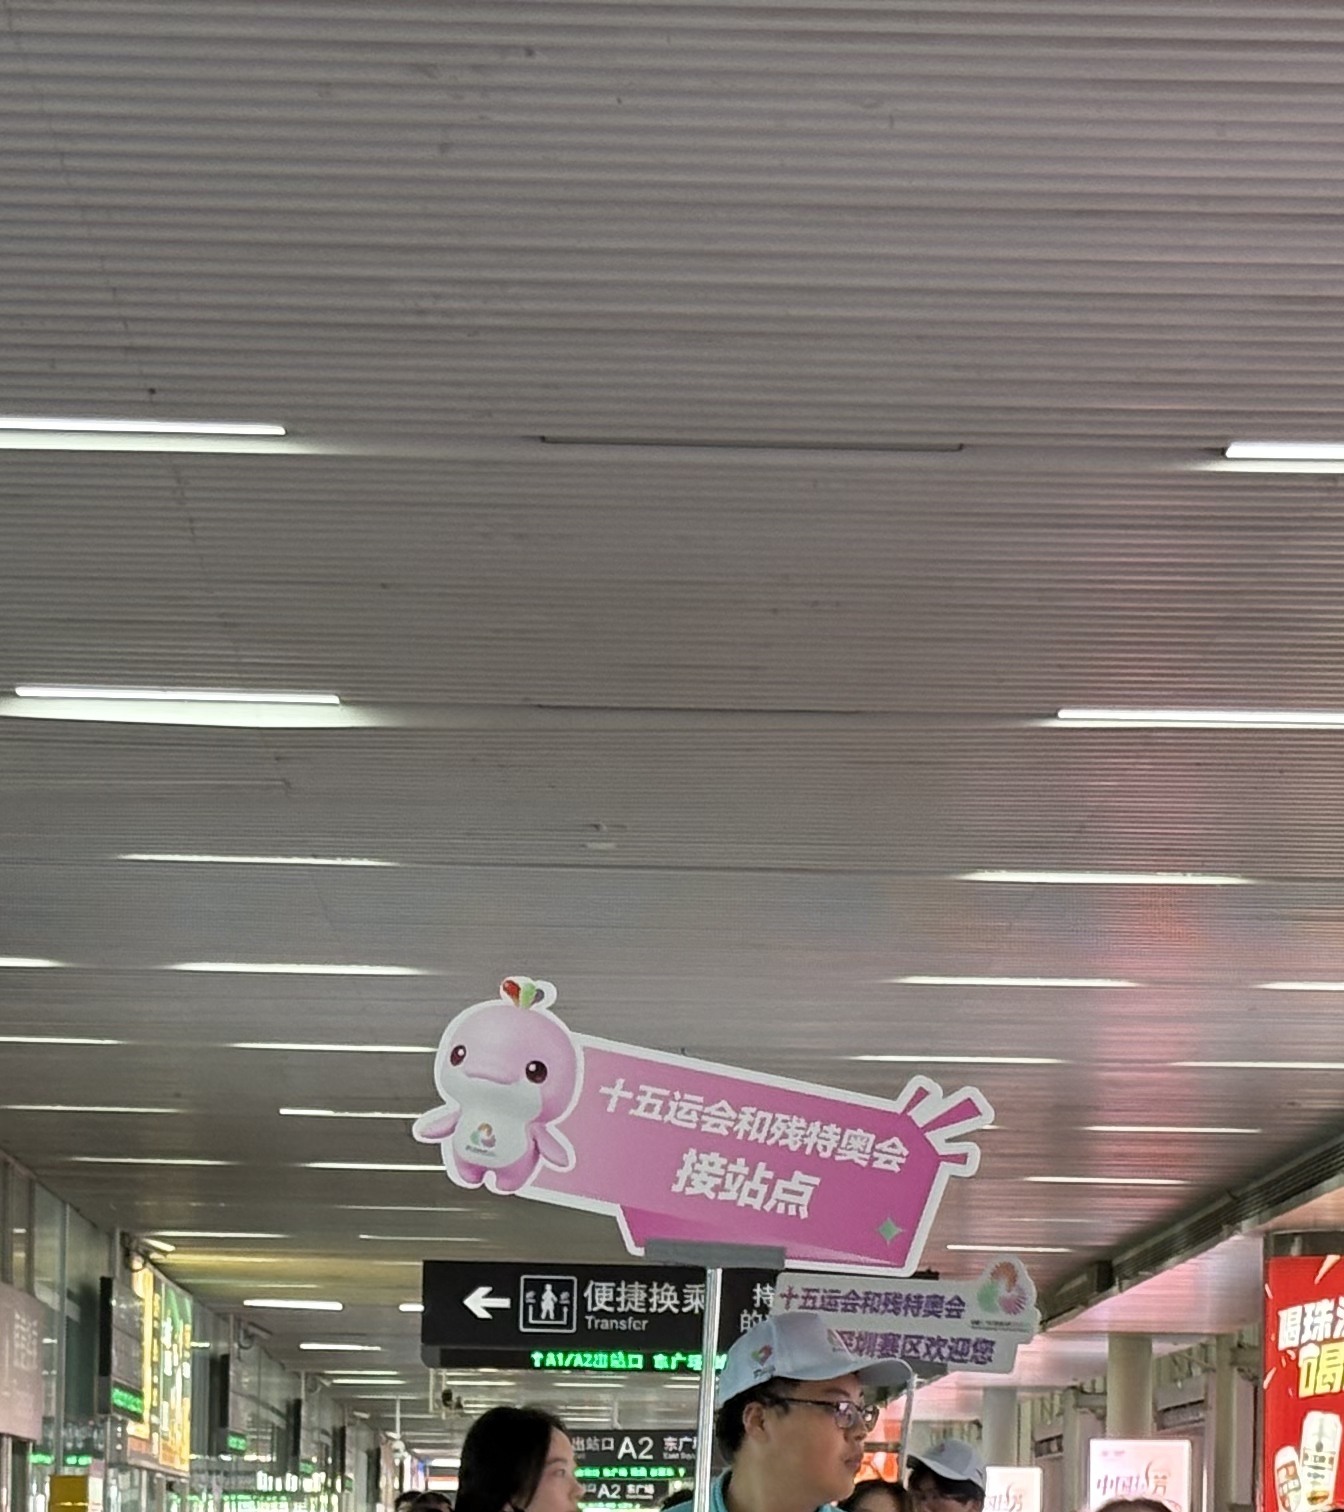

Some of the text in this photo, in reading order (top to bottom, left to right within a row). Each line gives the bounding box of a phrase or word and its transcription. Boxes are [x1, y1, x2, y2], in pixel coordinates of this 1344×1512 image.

[599, 1078, 910, 1174] 十五运会和残特奥会
[670, 1147, 822, 1220] 接站点
[583, 1279, 706, 1316] 便捷换乘
[779, 1284, 967, 1320] 十五运会和残特奥会
[584, 1314, 650, 1332] Transfer
[617, 1435, 655, 1460] A2
[597, 1483, 622, 1499] A2
